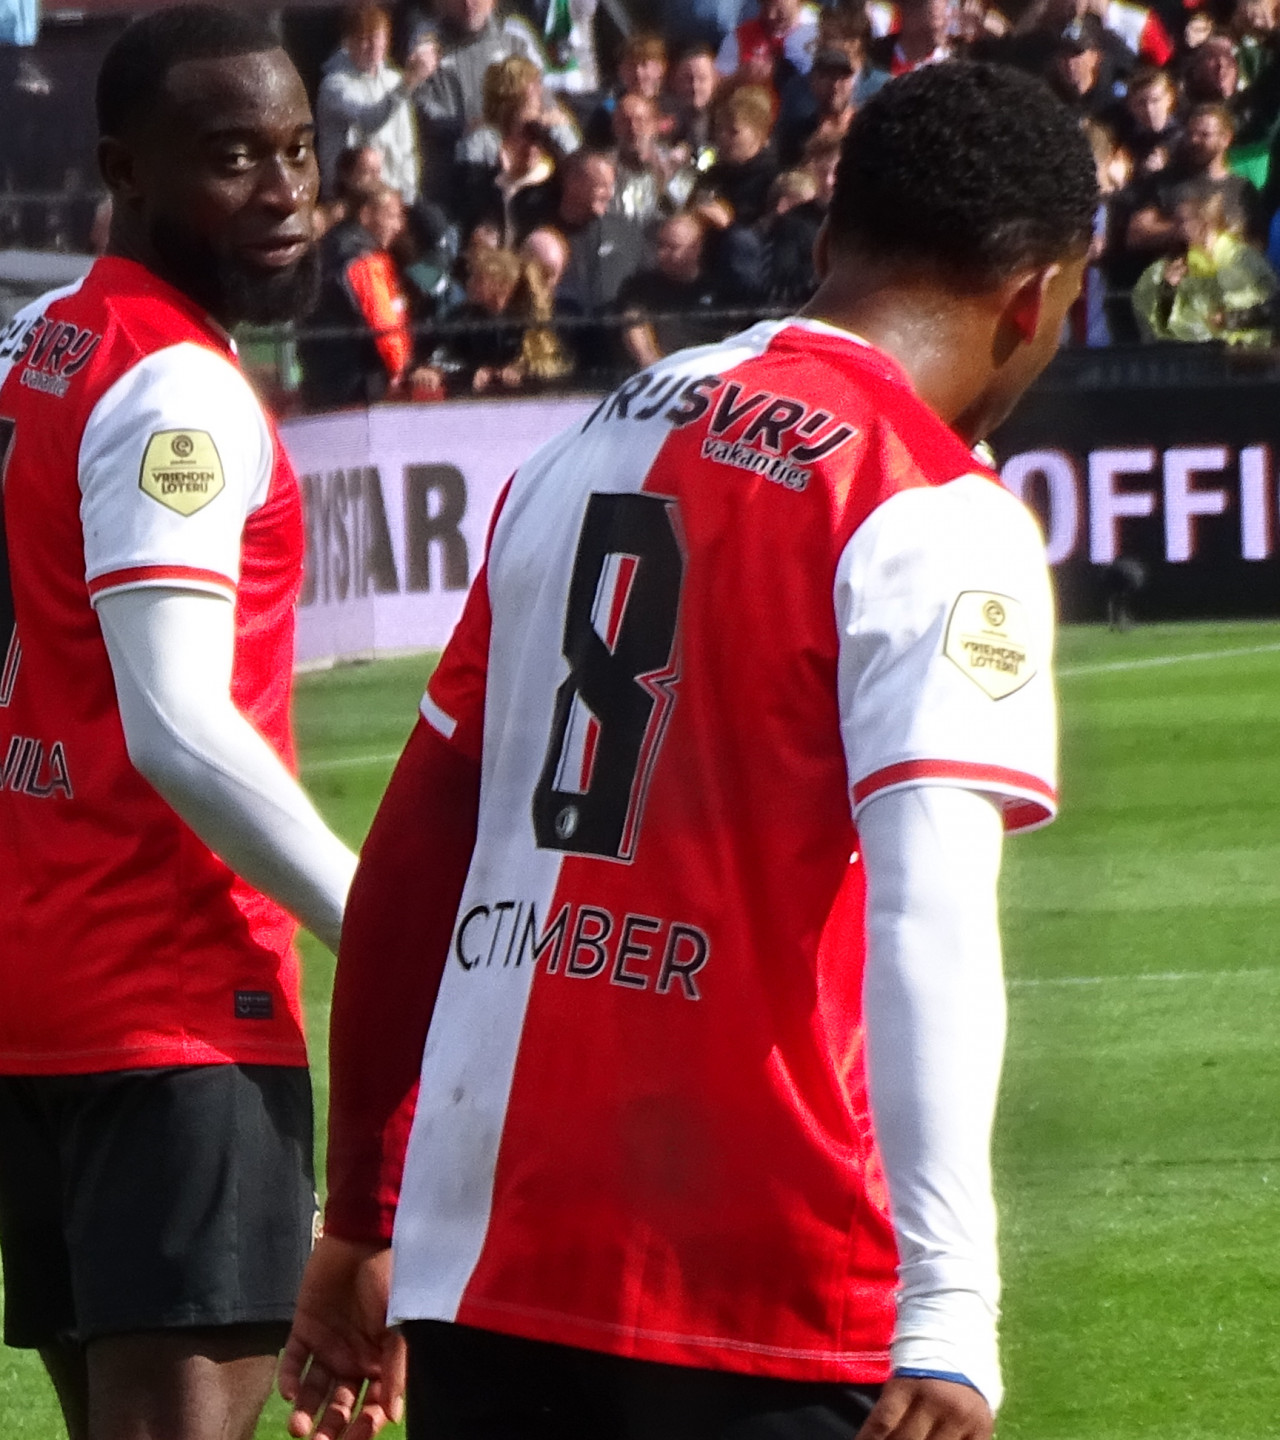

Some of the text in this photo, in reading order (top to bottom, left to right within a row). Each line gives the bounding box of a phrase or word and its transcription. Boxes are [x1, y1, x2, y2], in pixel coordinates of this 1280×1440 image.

[151, 472, 215, 483] VRIENDEN
[161, 482, 209, 495] LOTERIJ
[700, 437, 812, 492] vakanties
[1000, 445, 1280, 567] OFFI
[531, 491, 689, 865] 8
